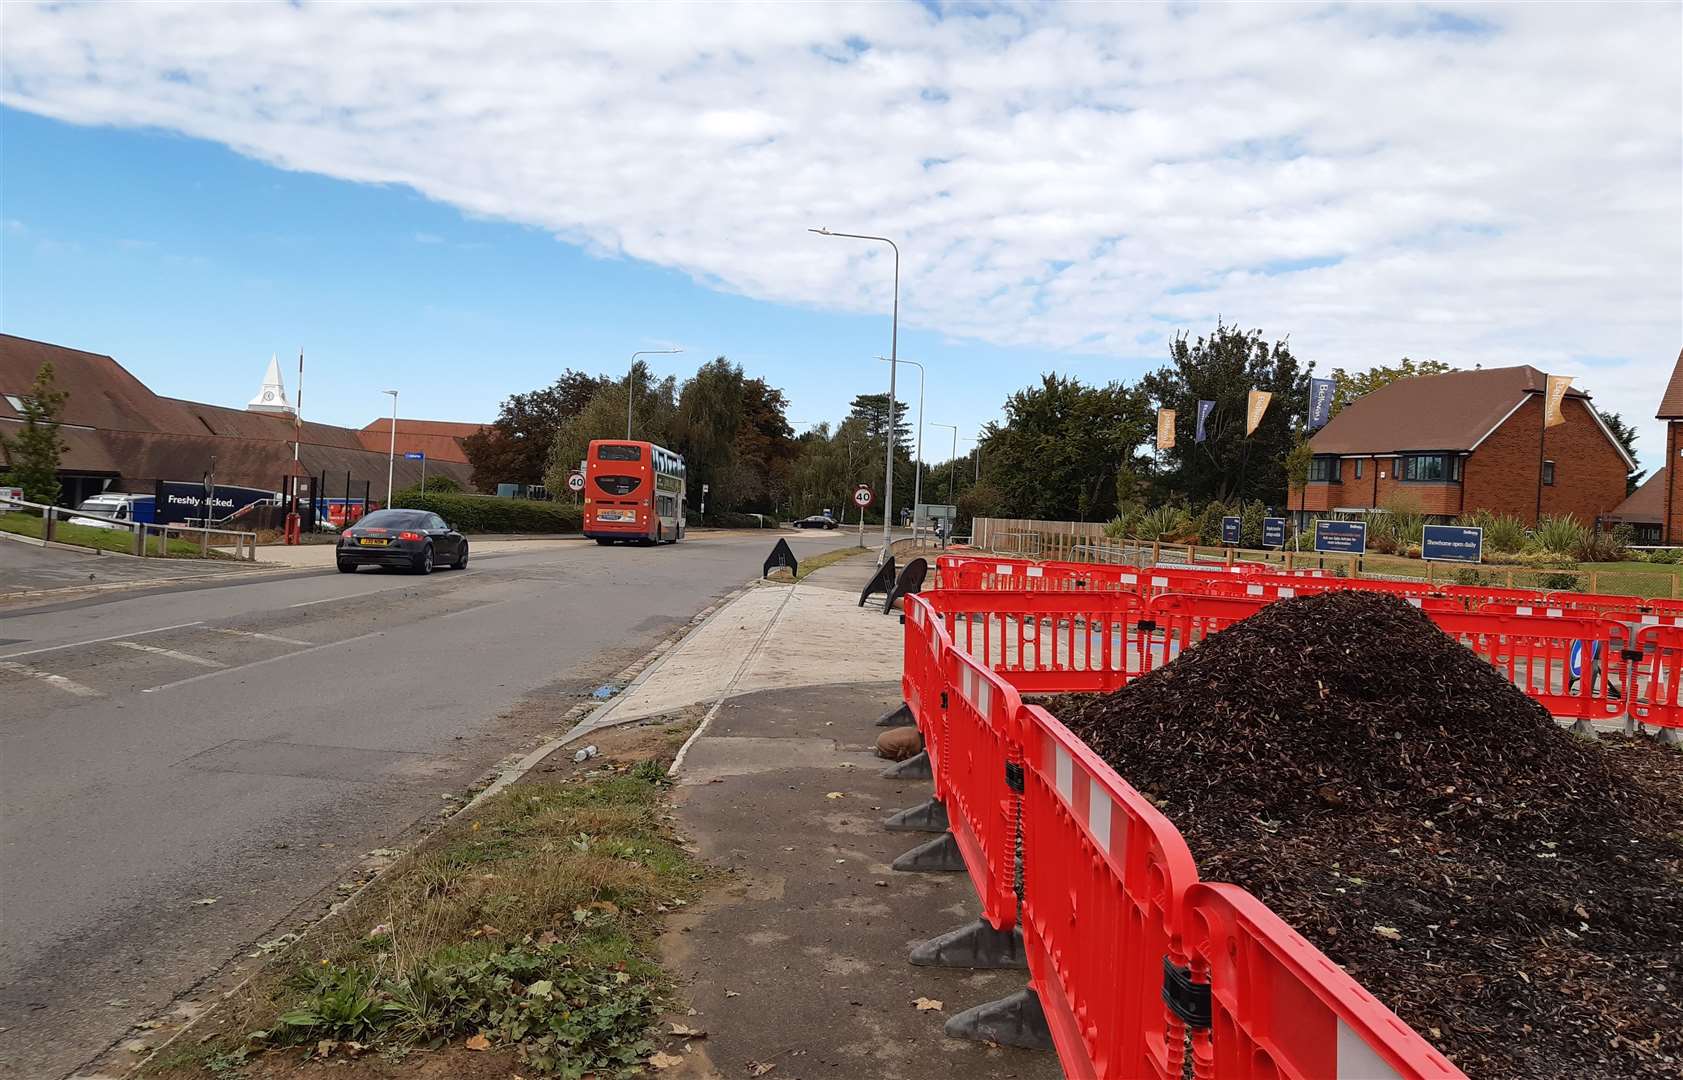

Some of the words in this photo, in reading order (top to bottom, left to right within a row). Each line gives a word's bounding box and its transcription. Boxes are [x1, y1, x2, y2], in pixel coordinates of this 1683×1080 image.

[1314, 384, 1328, 421] Bellway
[168, 494, 200, 507] Freshly
[857, 493, 869, 501] 40
